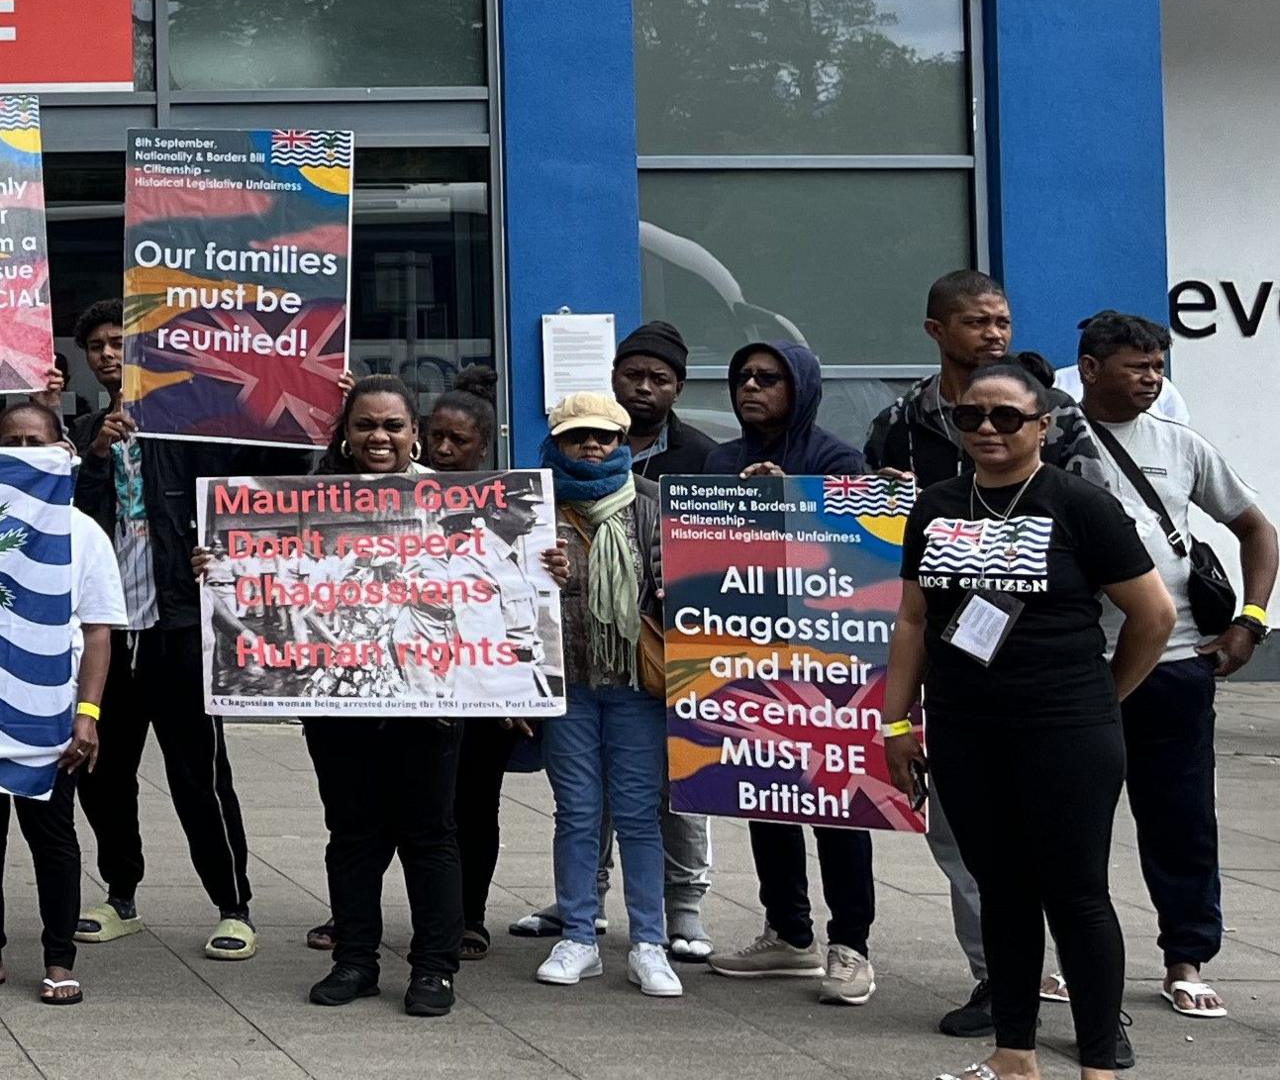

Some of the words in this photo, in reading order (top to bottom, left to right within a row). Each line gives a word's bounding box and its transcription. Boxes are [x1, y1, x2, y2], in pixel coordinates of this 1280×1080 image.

[22, 236, 36, 252] a
[135, 240, 195, 269] Our
[205, 241, 337, 275] families
[166, 285, 244, 310] must
[256, 286, 302, 313] be
[1168, 280, 1280, 339] ev
[157, 325, 308, 357] reunited!
[214, 481, 400, 515] Mauritian
[414, 479, 508, 511] Govt
[669, 485, 687, 496] 8th
[691, 485, 762, 499] September,
[671, 500, 734, 513] Nationality
[738, 501, 746, 511] &
[750, 501, 796, 512] Borders
[800, 502, 817, 513] Bill
[671, 529, 726, 540] Historical
[730, 530, 793, 542] Legislative
[797, 532, 861, 543] Unfairness
[680, 515, 745, 527] Citizenship
[228, 528, 324, 560] Don't
[335, 527, 486, 564] respect
[236, 574, 492, 613] Chagossians
[720, 566, 764, 594] All
[777, 567, 854, 597] Illois
[674, 607, 895, 644] Chagossian
[237, 635, 383, 668] Human
[398, 631, 520, 676] rights
[710, 652, 779, 680] and
[790, 653, 871, 685] their
[221, 698, 273, 708] Chagossian
[315, 699, 340, 709] being
[343, 700, 381, 708] arrested
[385, 700, 417, 709] during
[505, 700, 525, 708] Port
[720, 737, 812, 769] MUST
[825, 743, 866, 774] BE
[739, 781, 850, 818] British!
